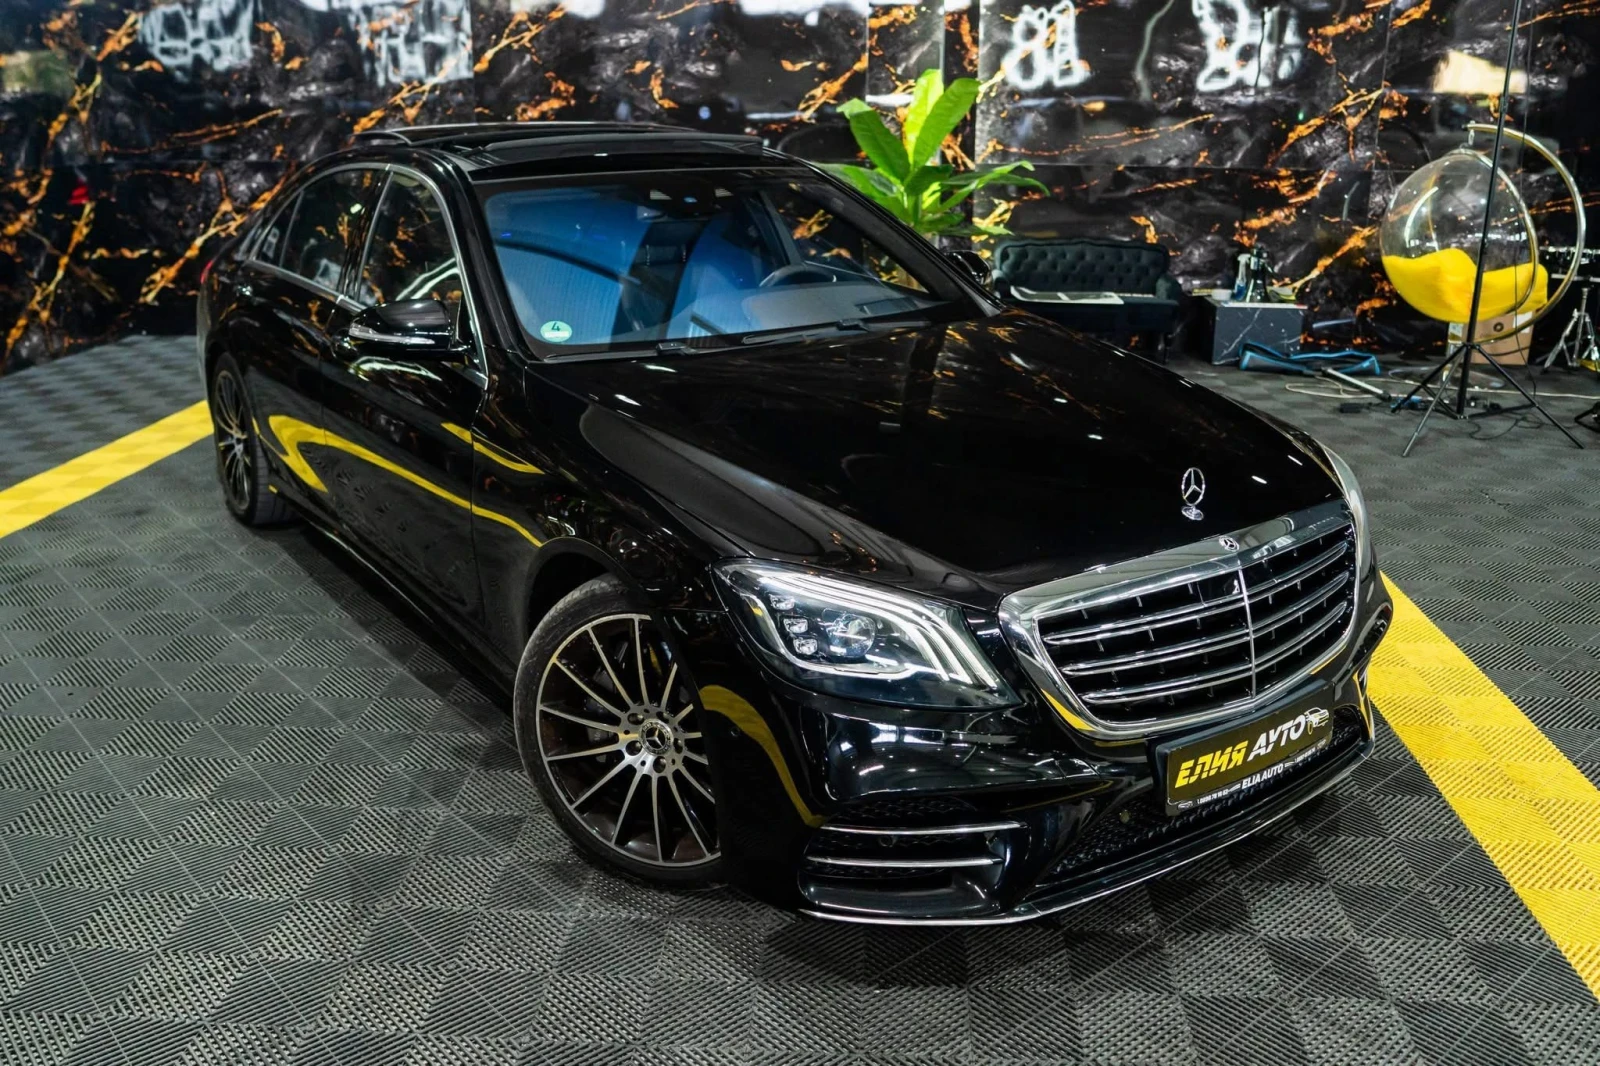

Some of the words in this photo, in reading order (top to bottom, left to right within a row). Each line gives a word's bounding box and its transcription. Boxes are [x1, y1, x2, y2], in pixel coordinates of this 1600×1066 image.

[551, 322, 561, 332] 4
[1175, 740, 1249, 788] ЕЛИЯ
[1260, 763, 1284, 782] AUTO
